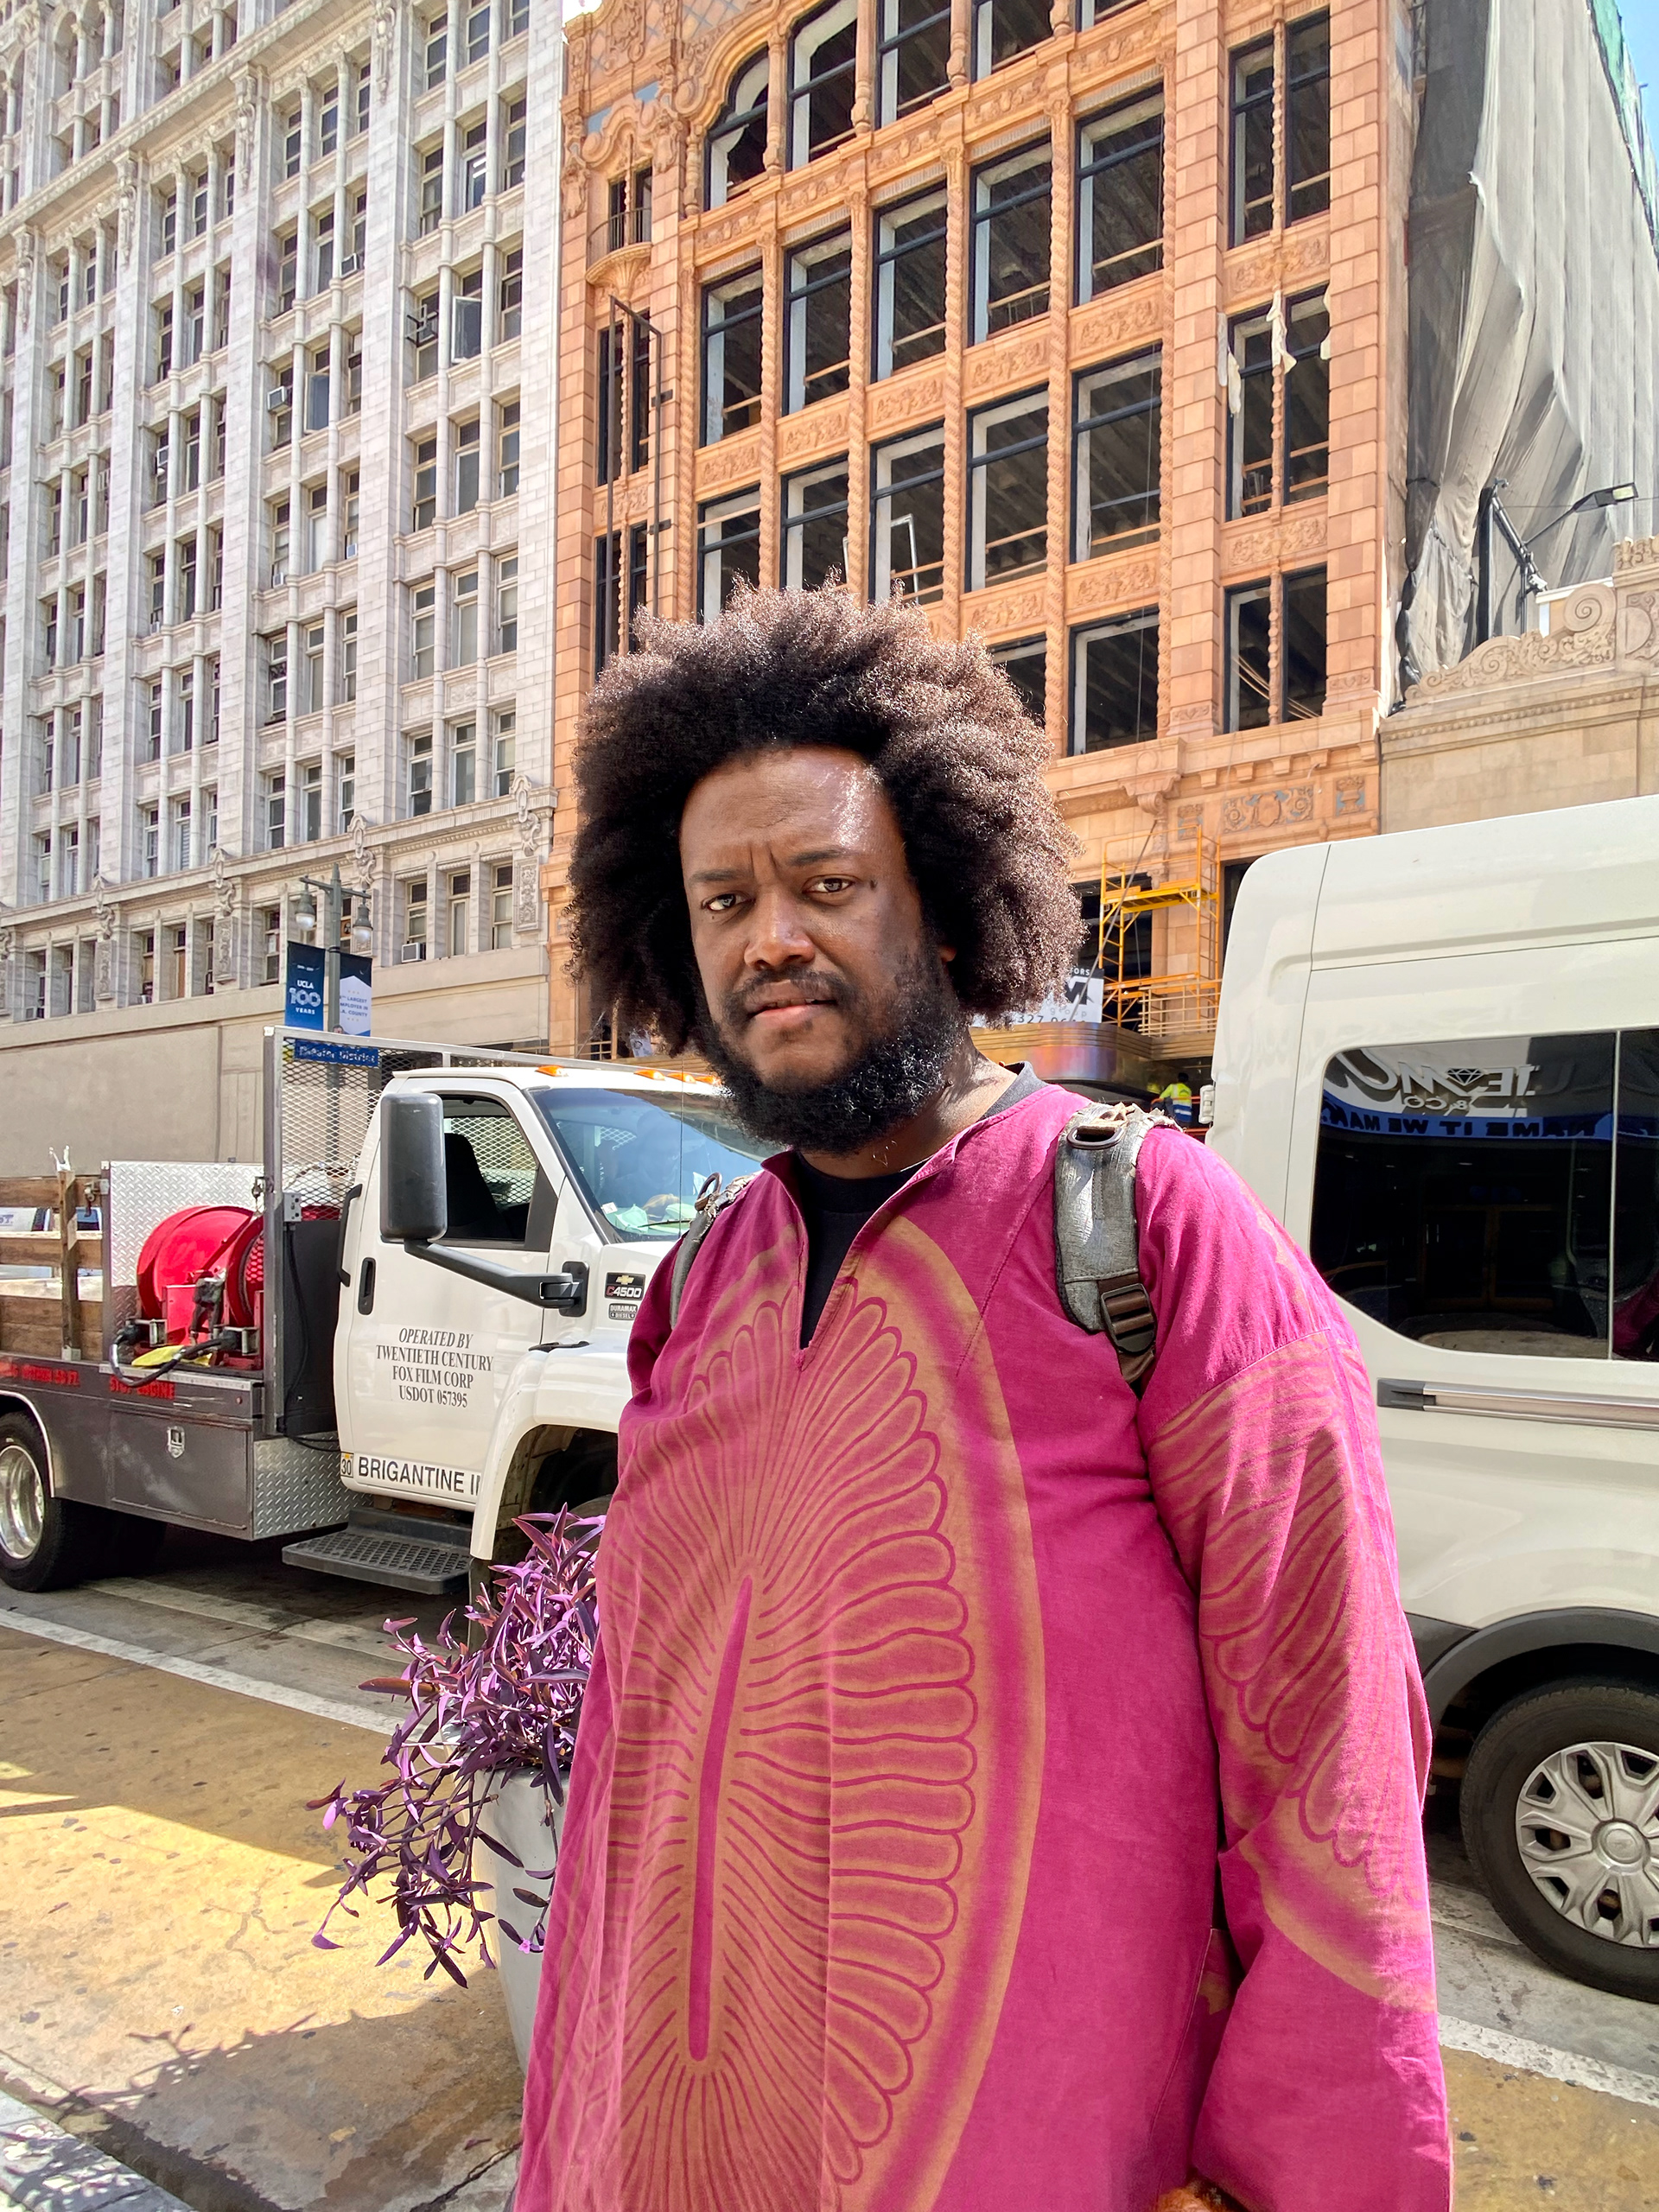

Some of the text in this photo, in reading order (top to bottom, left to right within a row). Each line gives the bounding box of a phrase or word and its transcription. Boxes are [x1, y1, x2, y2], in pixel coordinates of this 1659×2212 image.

[296, 979, 315, 989] UCLA
[289, 987, 321, 1007] 100
[1050, 1006, 1087, 1019] grop
[606, 1286, 642, 1298] C4500
[398, 1327, 474, 1349] OPERATED BY
[376, 1344, 494, 1371] TWENTIETH CENTURY
[392, 1365, 474, 1389] FOX FILM CORP
[398, 1384, 467, 1408] USDOT 057395
[340, 1458, 352, 1476] 30
[359, 1456, 465, 1493] BRIGANTINE
